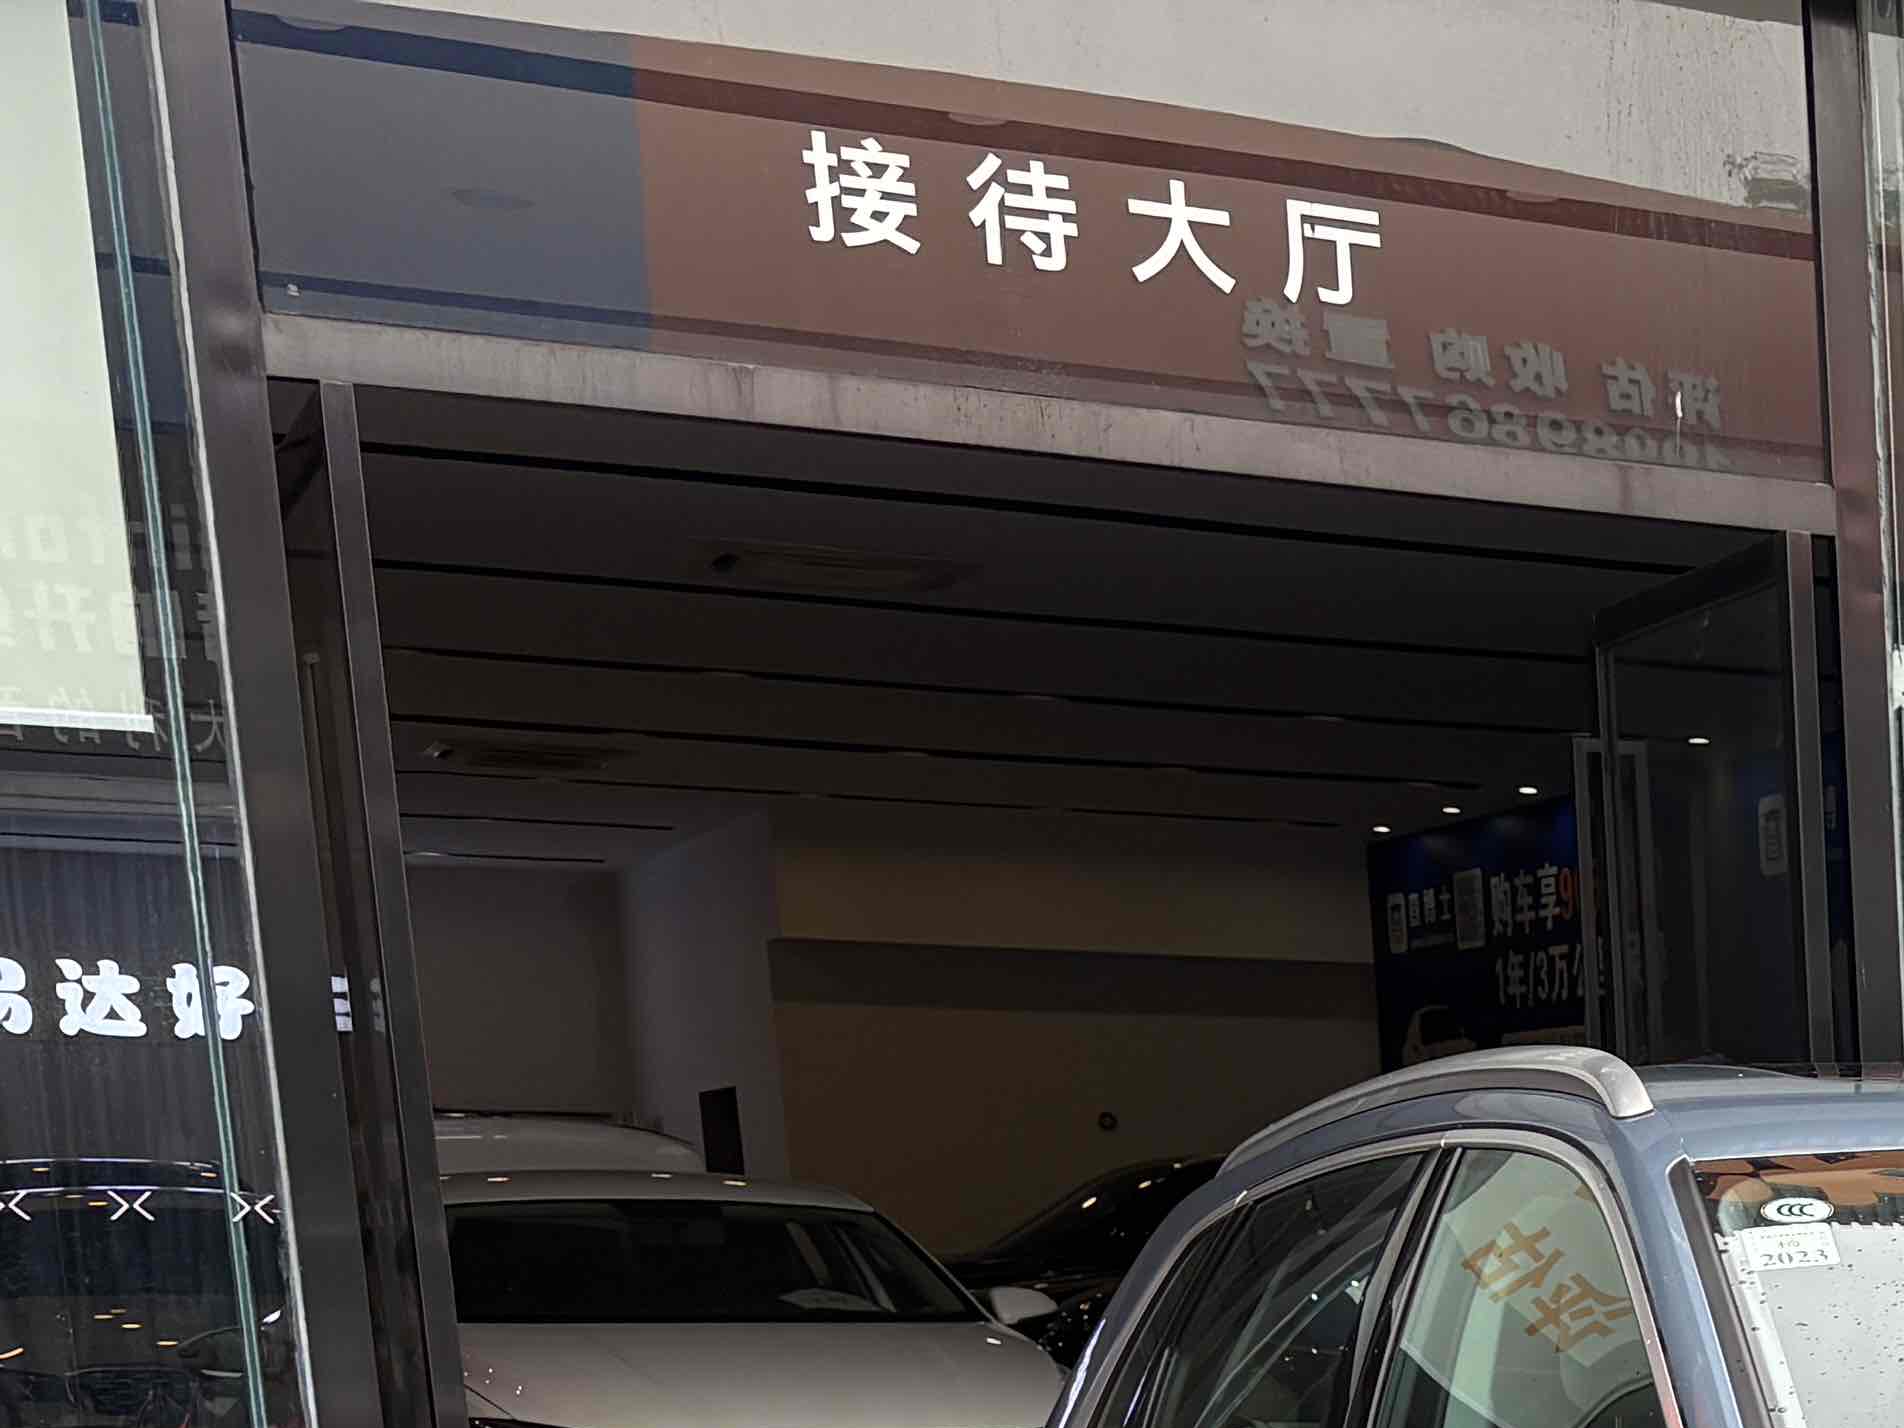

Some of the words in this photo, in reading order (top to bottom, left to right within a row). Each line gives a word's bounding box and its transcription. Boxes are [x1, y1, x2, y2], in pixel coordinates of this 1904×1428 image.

[802, 130, 1382, 306] 接待大厅
[1760, 1249, 1829, 1267] 2023
